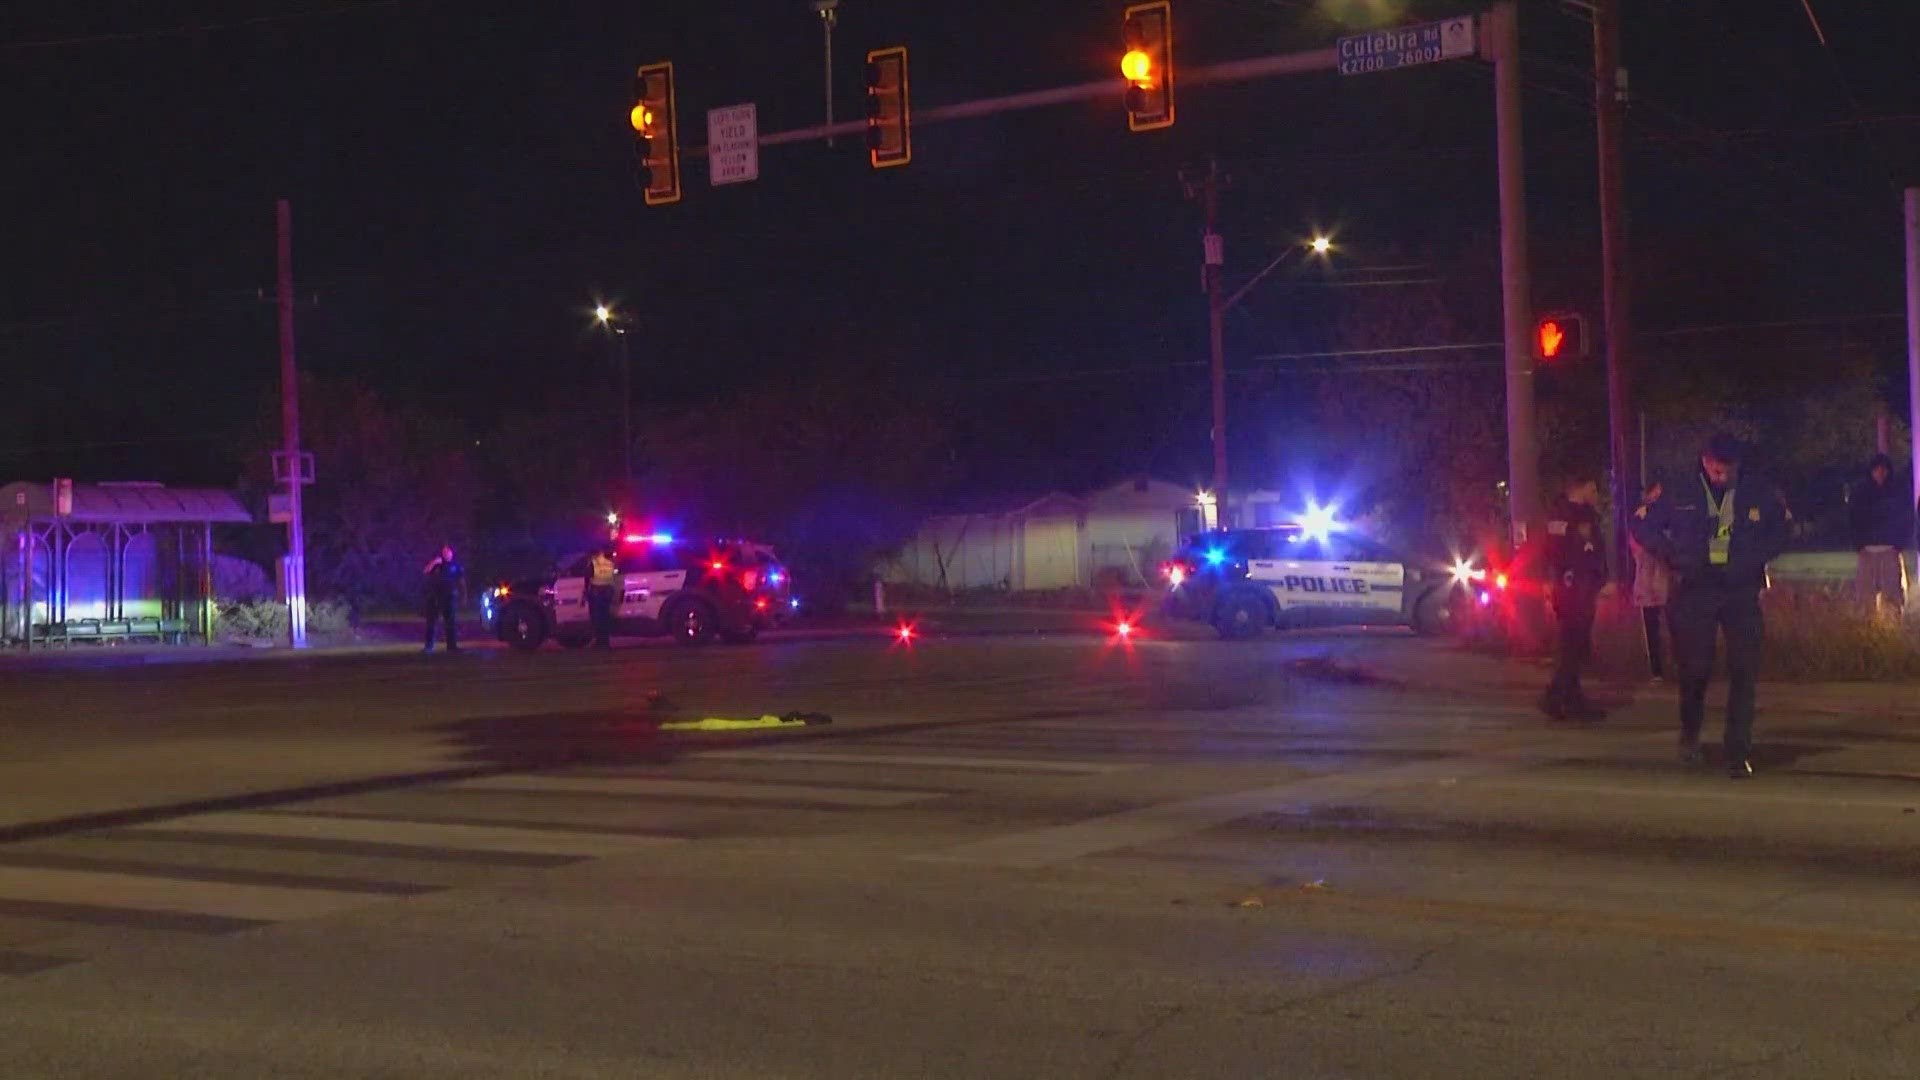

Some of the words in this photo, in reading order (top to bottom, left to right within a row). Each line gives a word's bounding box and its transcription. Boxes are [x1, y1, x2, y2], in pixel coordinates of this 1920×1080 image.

[1342, 32, 1417, 57] Culebra
[1351, 54, 1384, 72] 2700
[1398, 47, 1432, 65] 2600
[721, 126, 746, 138] YIELD
[1284, 575, 1368, 594] POLICE
